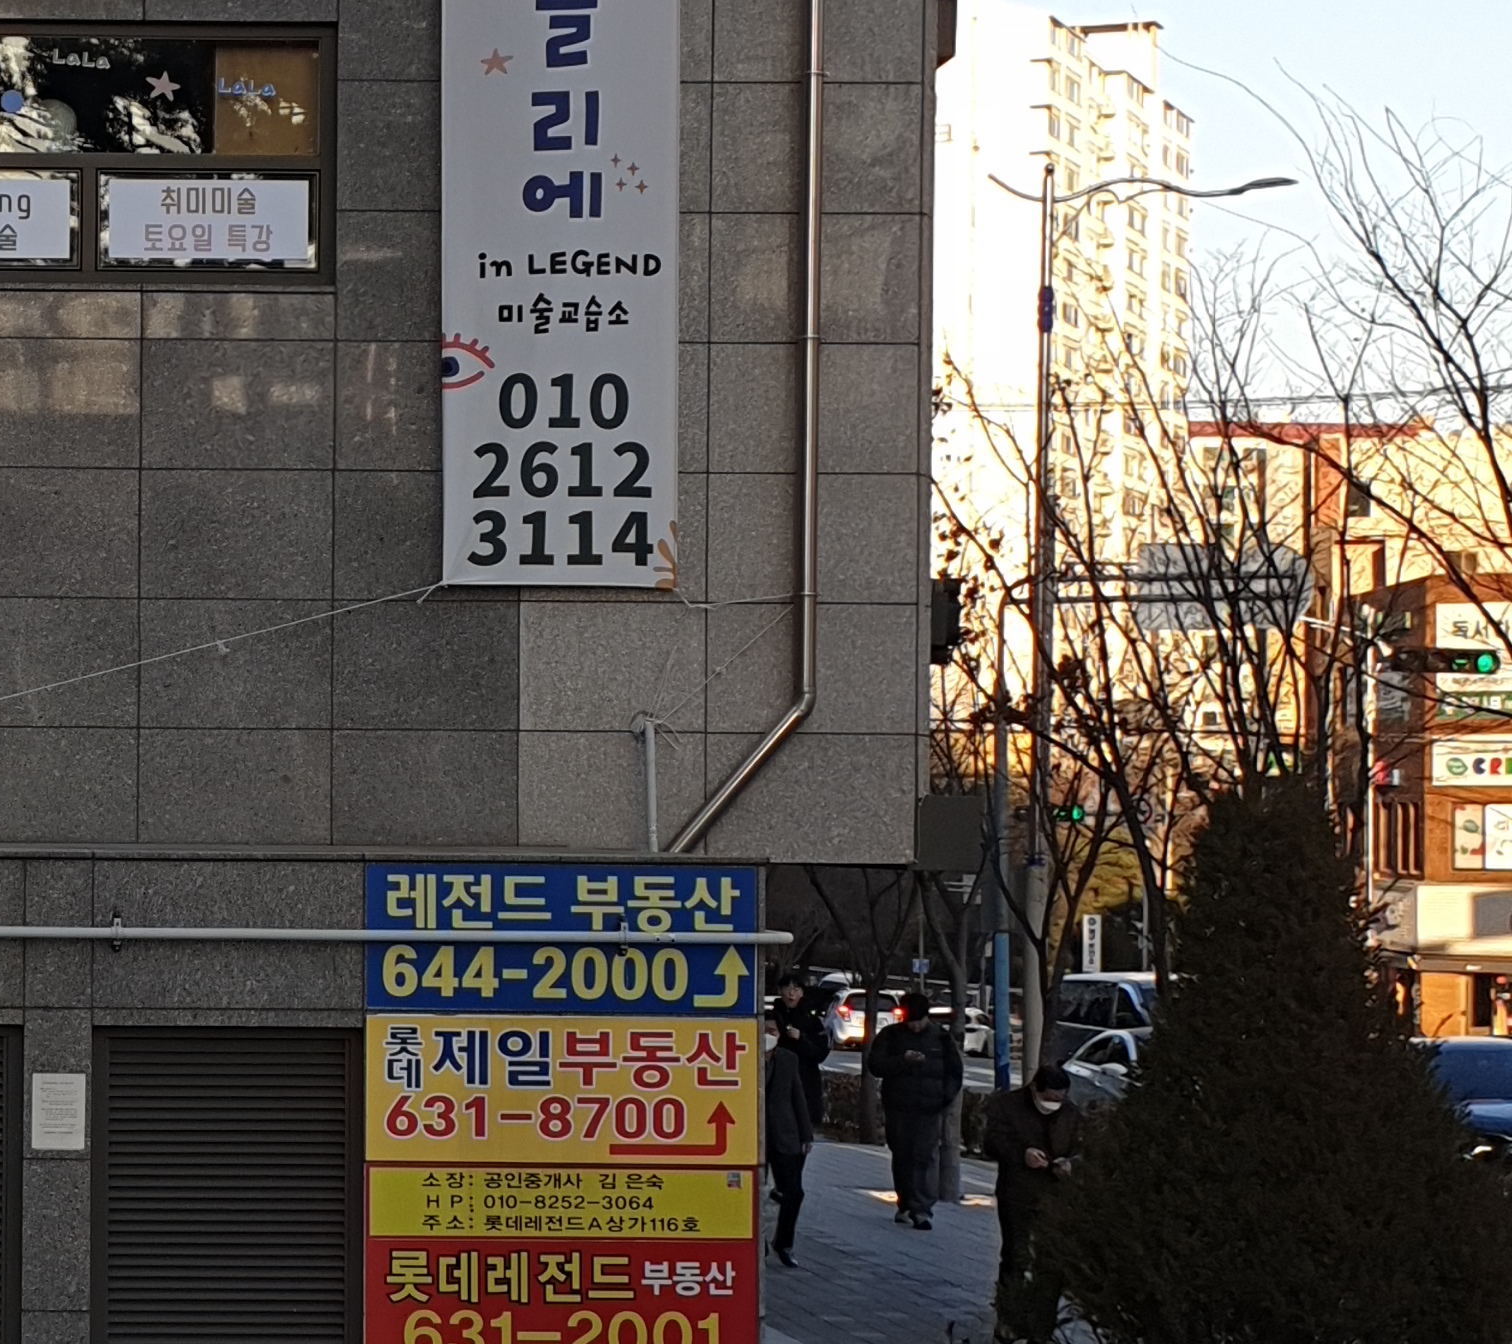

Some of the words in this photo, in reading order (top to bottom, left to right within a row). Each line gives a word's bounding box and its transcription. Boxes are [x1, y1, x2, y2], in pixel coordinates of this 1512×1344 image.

[51, 48, 110, 70] LaLa
[218, 77, 276, 97] LaLa
[160, 186, 257, 216] 취미미술
[144, 223, 213, 253] 토요일
[226, 223, 273, 253] 특강
[478, 252, 513, 278] in
[527, 250, 662, 277] LEGEND
[498, 292, 630, 334] 미술교습소
[498, 372, 629, 430] 010
[472, 441, 653, 498] 2612
[467, 510, 654, 566] 3114
[386, 873, 552, 930] 레전드
[570, 875, 741, 934] 부동산
[382, 944, 688, 1001] 644-2000
[432, 1029, 746, 1089] 제일부동산
[386, 1095, 685, 1140] 631-8700
[483, 1172, 583, 1189] 공인중개사
[483, 1194, 654, 1210] 010-8252-3064
[387, 1250, 636, 1303] 롯데레전드
[641, 1260, 736, 1297] 부동산
